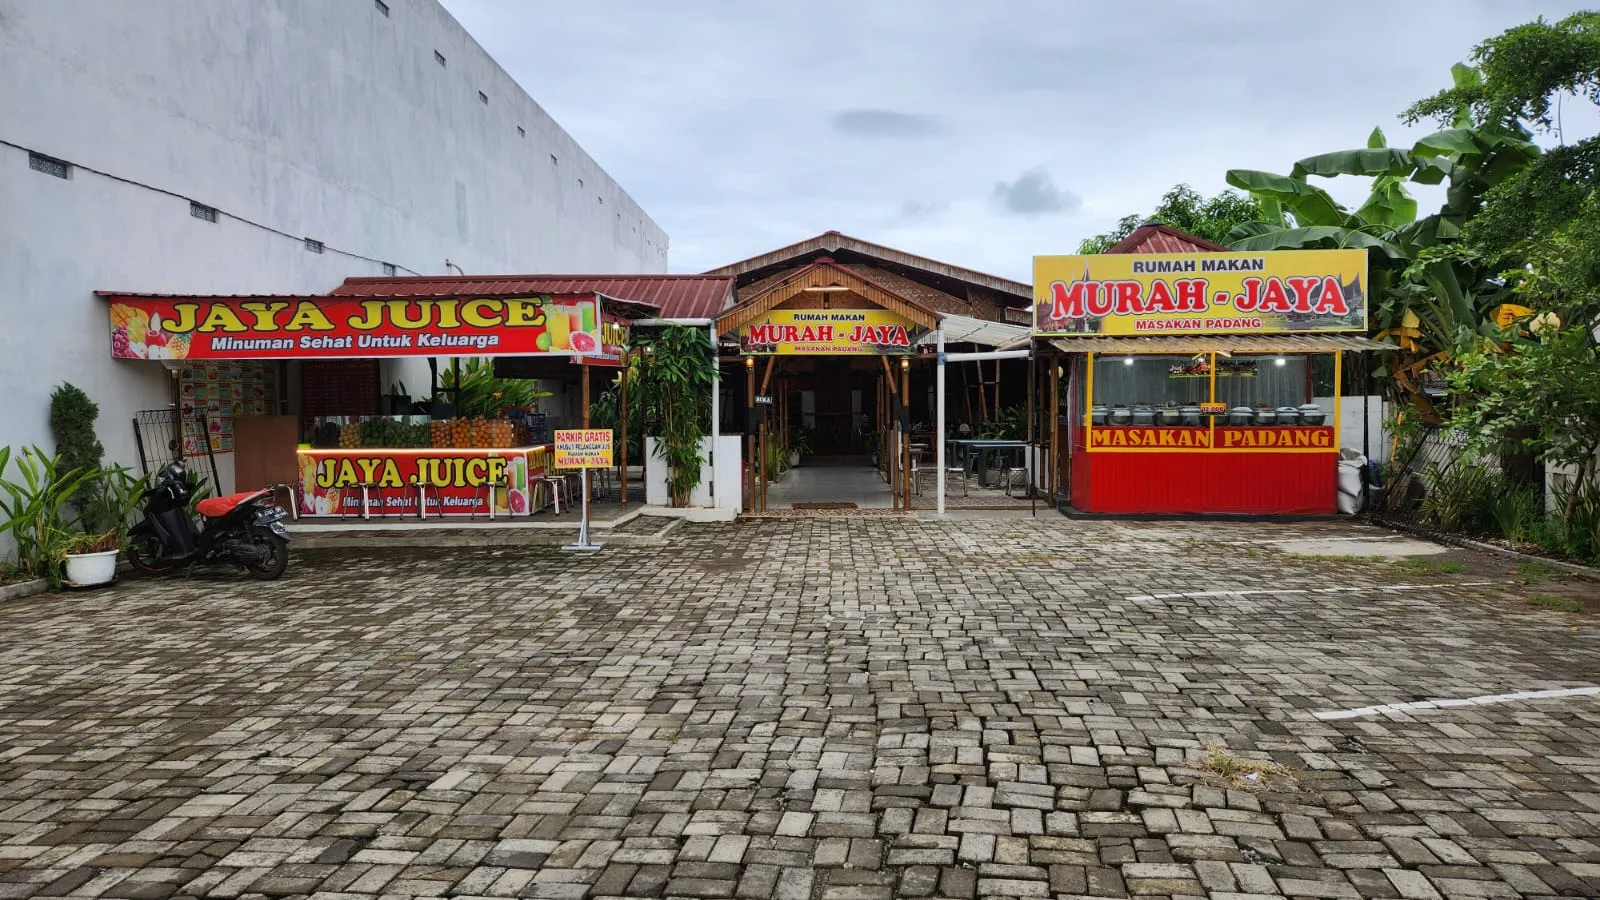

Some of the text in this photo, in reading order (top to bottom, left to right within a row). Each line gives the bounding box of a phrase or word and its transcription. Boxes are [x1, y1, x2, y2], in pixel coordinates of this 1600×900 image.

[1133, 258, 1264, 273] RUMAH MAKAN
[1050, 279, 1209, 319] MURAH
[1235, 276, 1350, 315] JAYA
[160, 295, 548, 333] JAYA JUICE
[793, 313, 865, 321] RUMAH MAKAN
[1135, 317, 1262, 331] MASAKAN PADANG
[210, 332, 500, 352] Minuman Sehat Untuk Keluarga
[748, 324, 834, 345] MURAH
[849, 324, 910, 346] JAYA
[556, 431, 610, 442] PARKIR GRATIS
[1092, 430, 1329, 447] MASAKAN PADANG
[317, 457, 403, 488] JAYA
[409, 456, 508, 488] JUICE
[386, 497, 412, 507] Sehat
[443, 496, 483, 508] Keluarga
